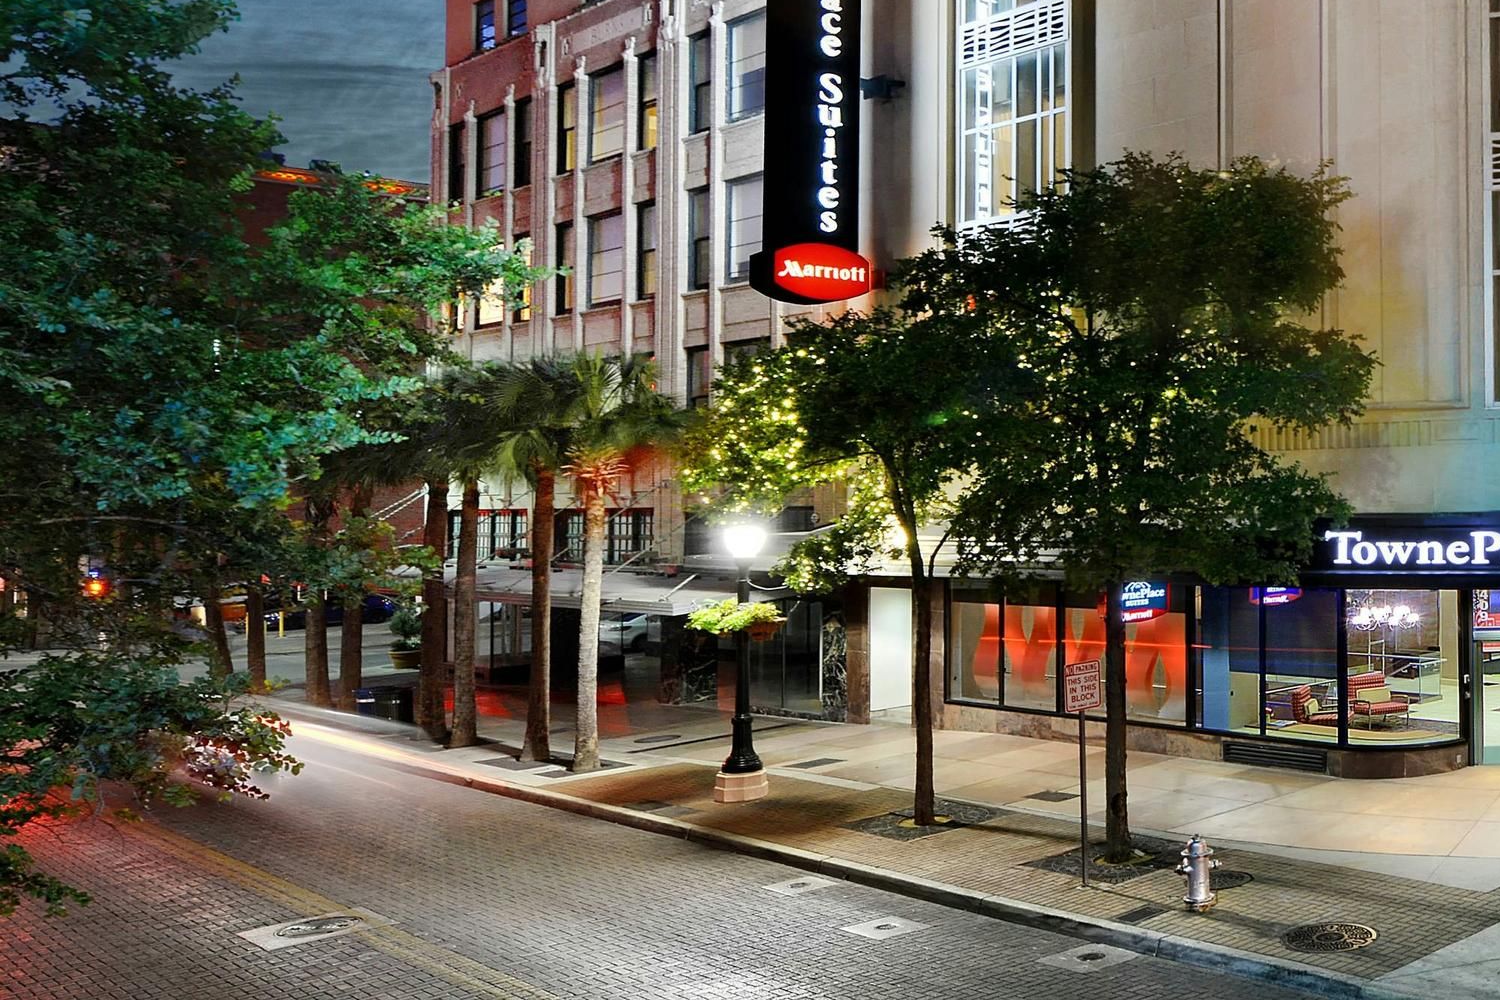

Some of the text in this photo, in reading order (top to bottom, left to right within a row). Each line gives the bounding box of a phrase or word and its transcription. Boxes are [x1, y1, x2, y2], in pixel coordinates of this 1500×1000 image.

[817, 73, 843, 232] Suites
[778, 259, 866, 282] Marriott
[1075, 663, 1097, 673] PARKING
[1068, 674, 1098, 686] THIS SIDE
[1080, 683, 1097, 692] THIS
[1071, 693, 1095, 703] BLOCK
